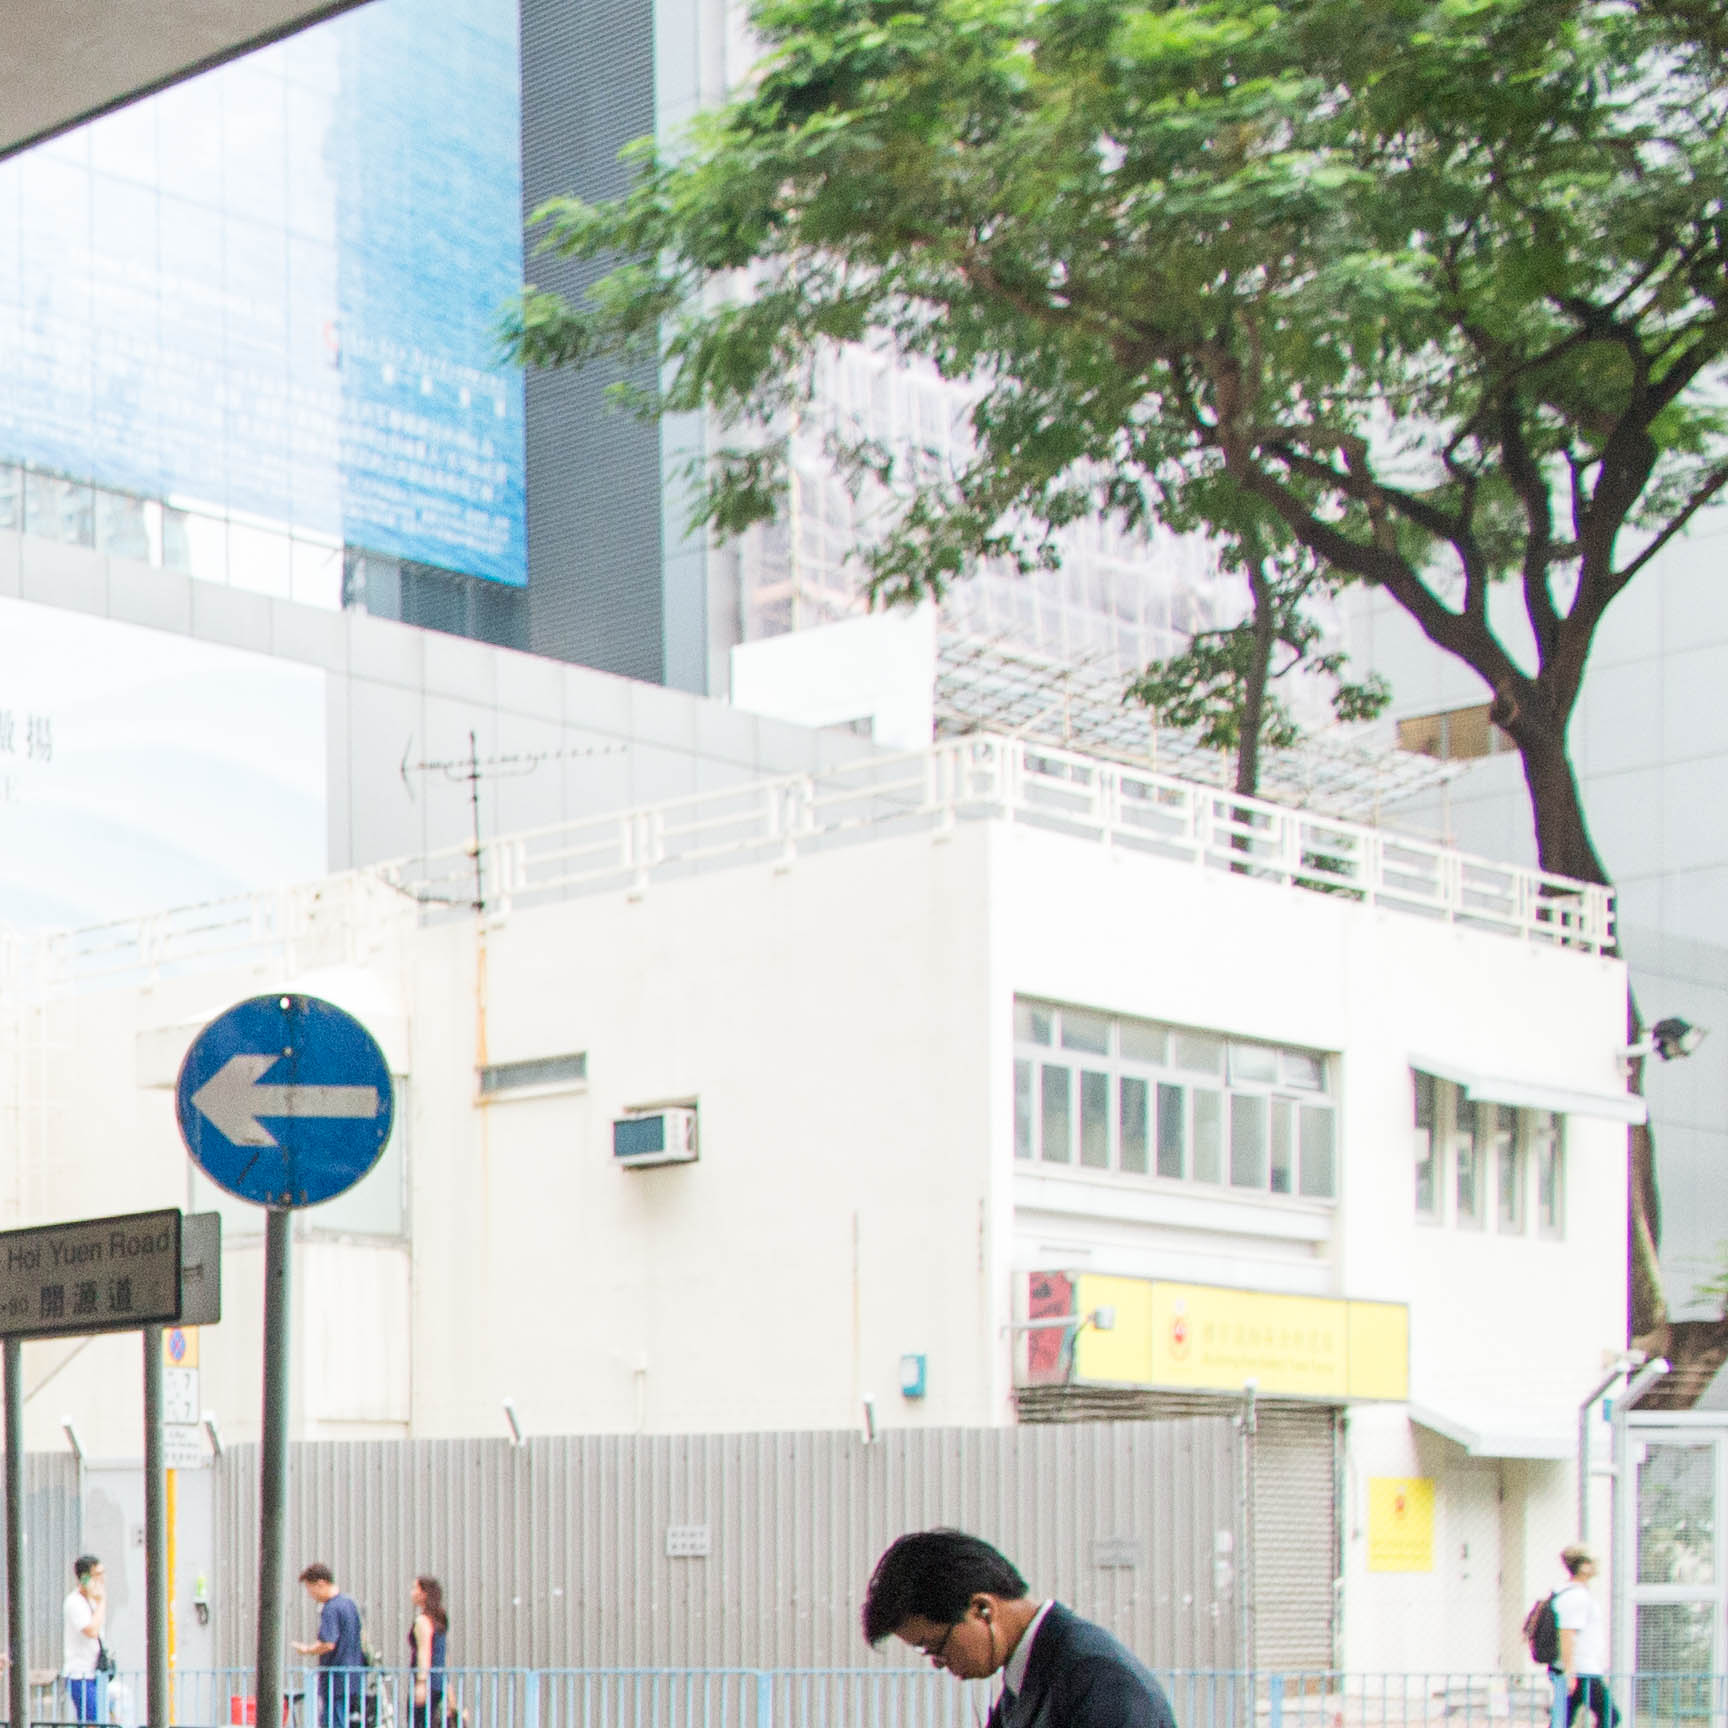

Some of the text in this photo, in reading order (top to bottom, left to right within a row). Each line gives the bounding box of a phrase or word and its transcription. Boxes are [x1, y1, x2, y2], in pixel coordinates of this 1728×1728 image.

[7, 1227, 170, 1271] Hoi Yuen Road
